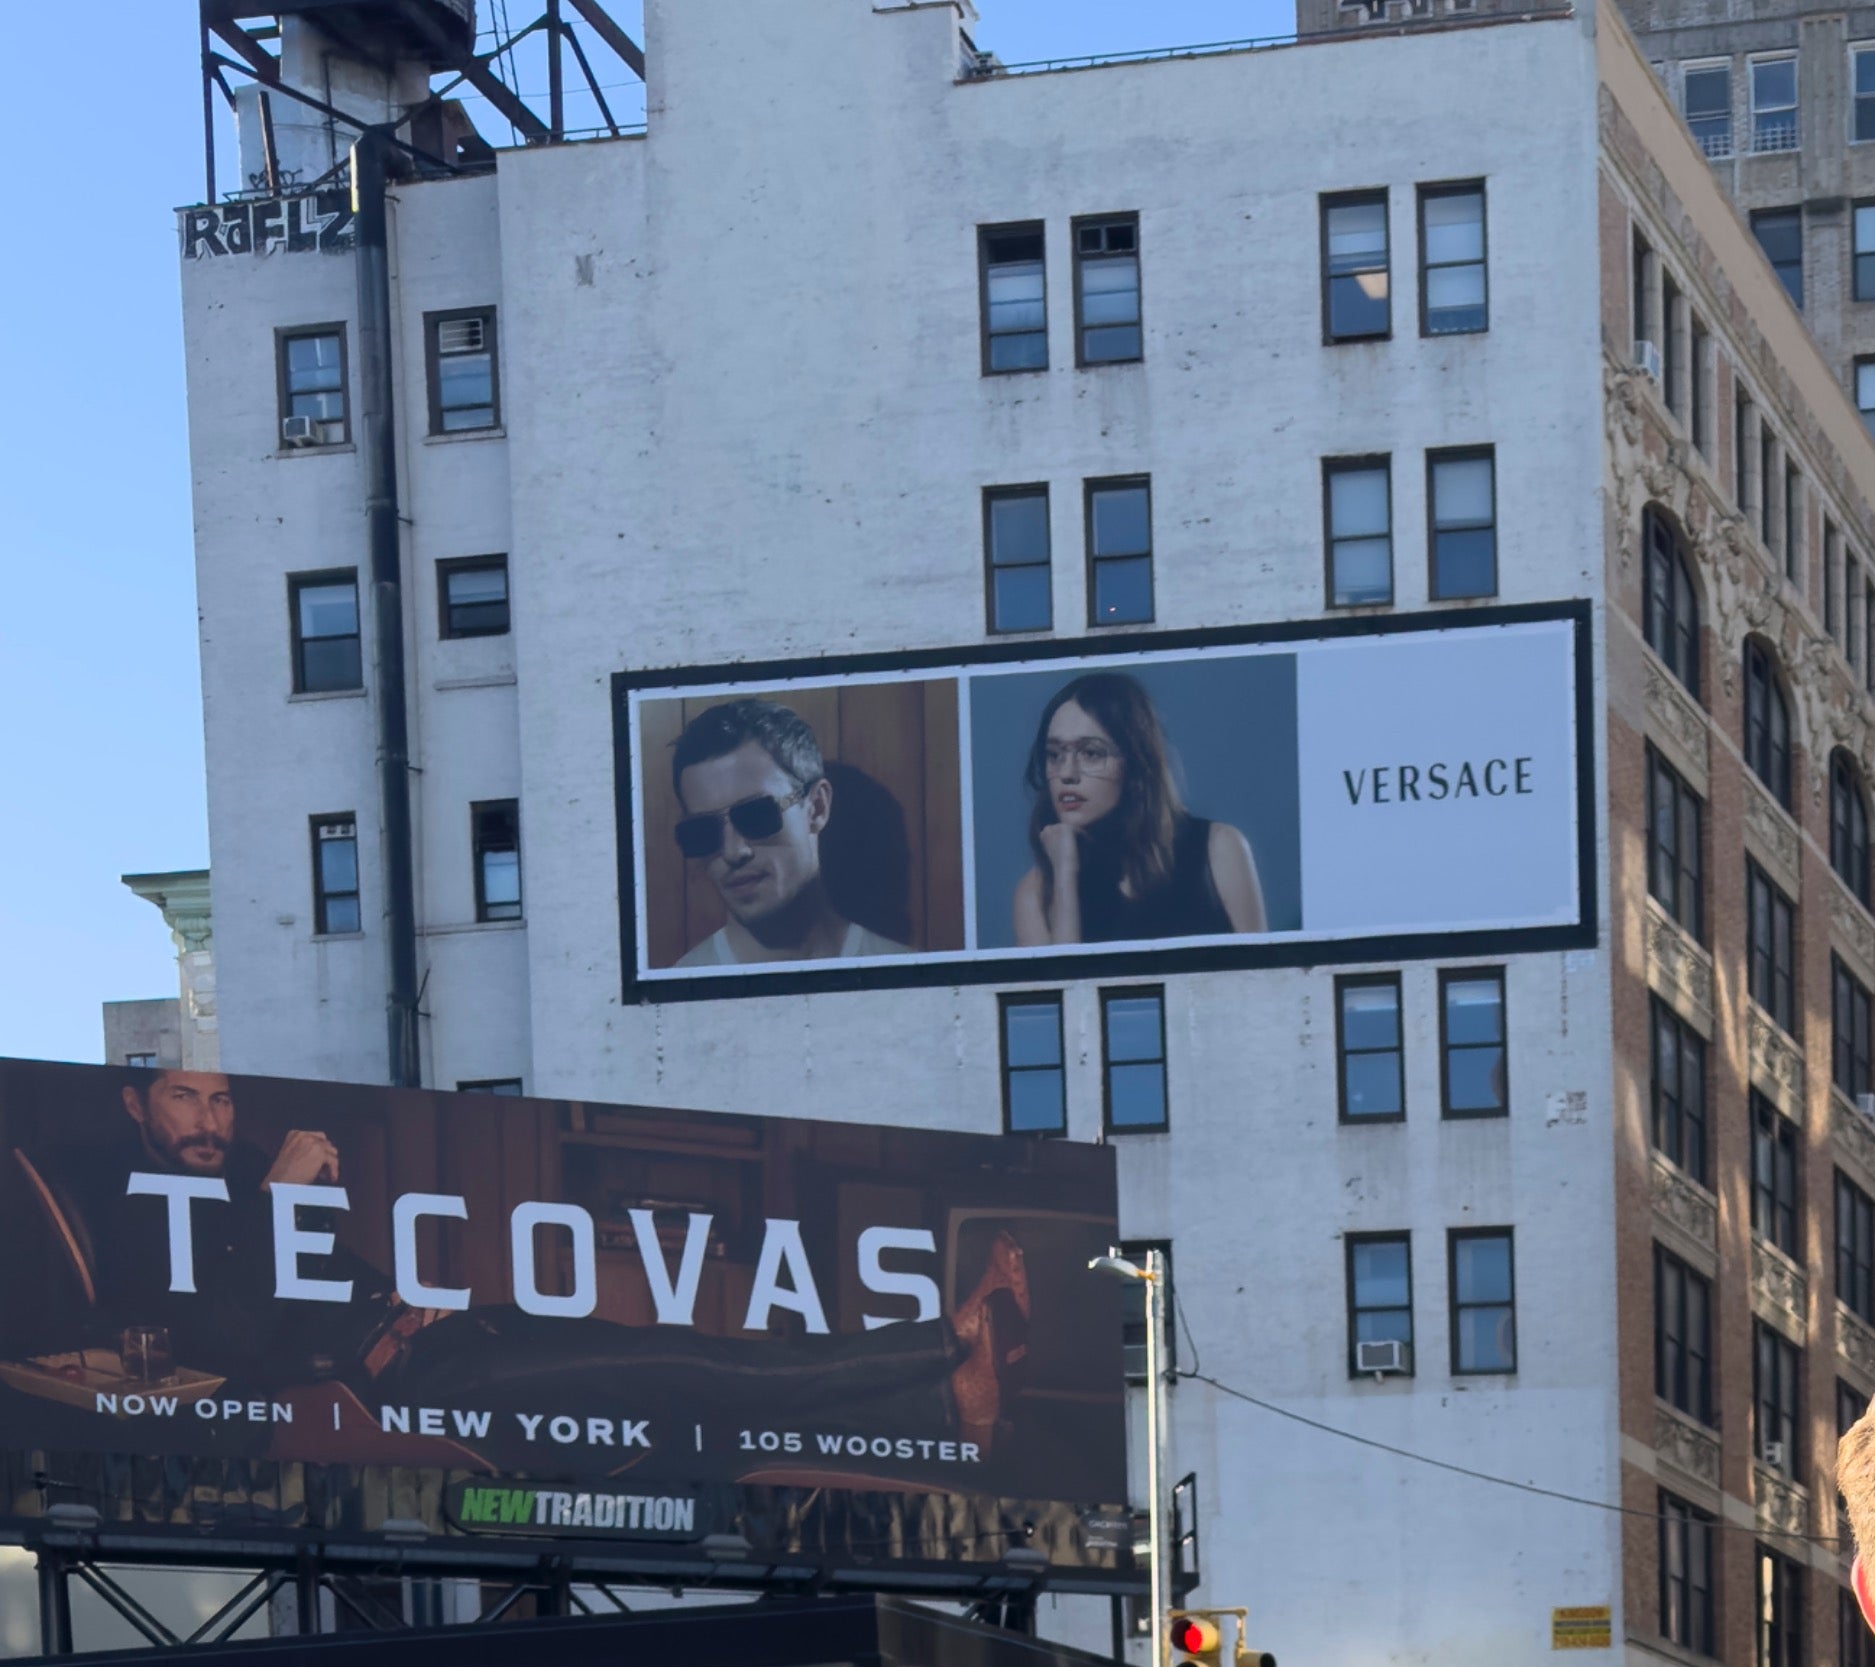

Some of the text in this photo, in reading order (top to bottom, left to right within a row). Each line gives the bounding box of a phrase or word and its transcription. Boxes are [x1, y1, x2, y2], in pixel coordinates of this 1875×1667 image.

[1343, 756, 1533, 806] VERSACE
[127, 1172, 941, 1334] TECOVAS
[95, 1392, 293, 1424] NOW OPEN
[381, 1404, 652, 1448] NEW YORK
[739, 1429, 980, 1463] 105 WOOSTER
